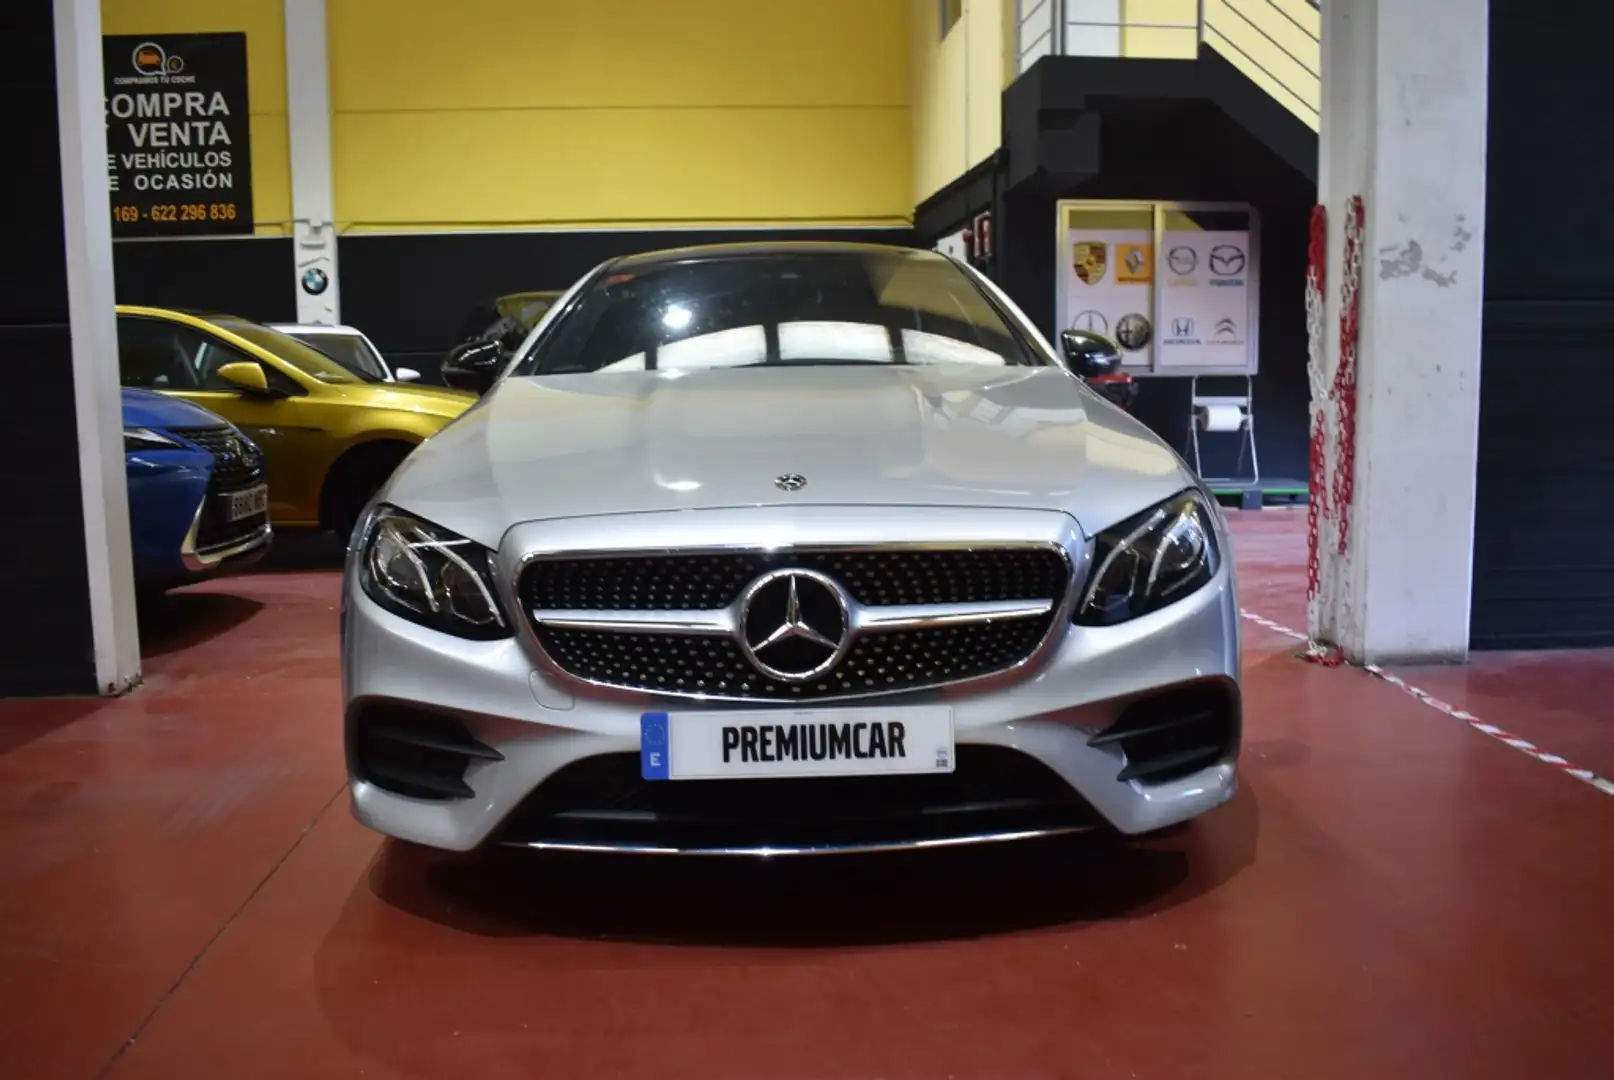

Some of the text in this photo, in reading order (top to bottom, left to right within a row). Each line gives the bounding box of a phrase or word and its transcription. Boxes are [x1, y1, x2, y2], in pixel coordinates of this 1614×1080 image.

[104, 91, 230, 118] OMPRA
[127, 121, 231, 147] VENTA
[121, 149, 232, 169] VEHÍCULOS
[134, 169, 233, 190] OCASIÓN
[151, 205, 177, 220] 622
[181, 204, 206, 220] 296
[210, 203, 236, 219] 836
[722, 721, 906, 763] PREMIUMCAR
[650, 752, 661, 767] E
